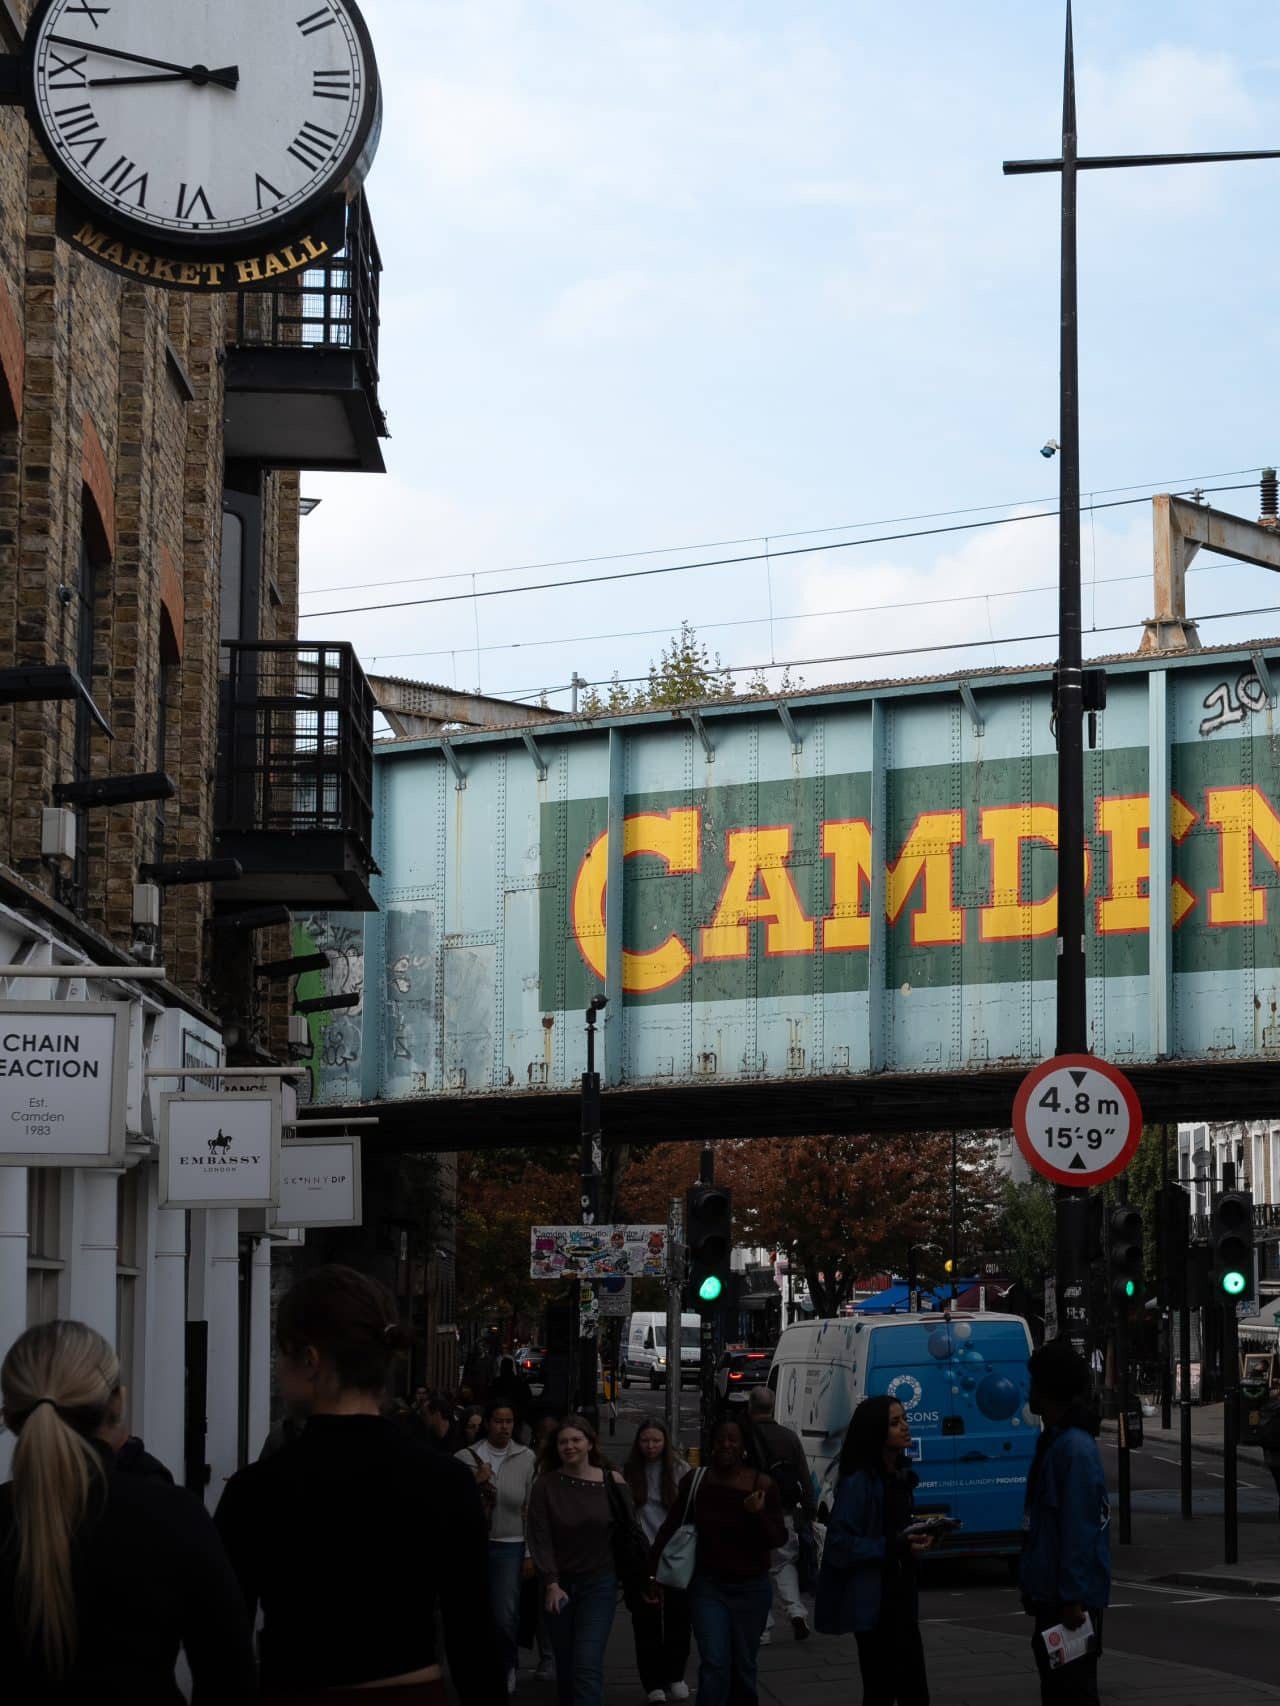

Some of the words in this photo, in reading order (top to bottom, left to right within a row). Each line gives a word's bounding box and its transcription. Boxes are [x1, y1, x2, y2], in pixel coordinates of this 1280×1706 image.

[312, 70, 351, 101] III
[255, 172, 287, 210] V
[72, 222, 226, 286] MARKET
[237, 235, 329, 283] HALL
[3, 1033, 80, 1053] CHAIN
[29, 1097, 49, 1109] Est.
[1038, 1086, 1091, 1115] 4.8
[1097, 1098, 1119, 1116] m
[10, 1111, 65, 1122] Camden
[24, 1125, 51, 1136] 1983
[179, 1155, 261, 1166] EMBASSY
